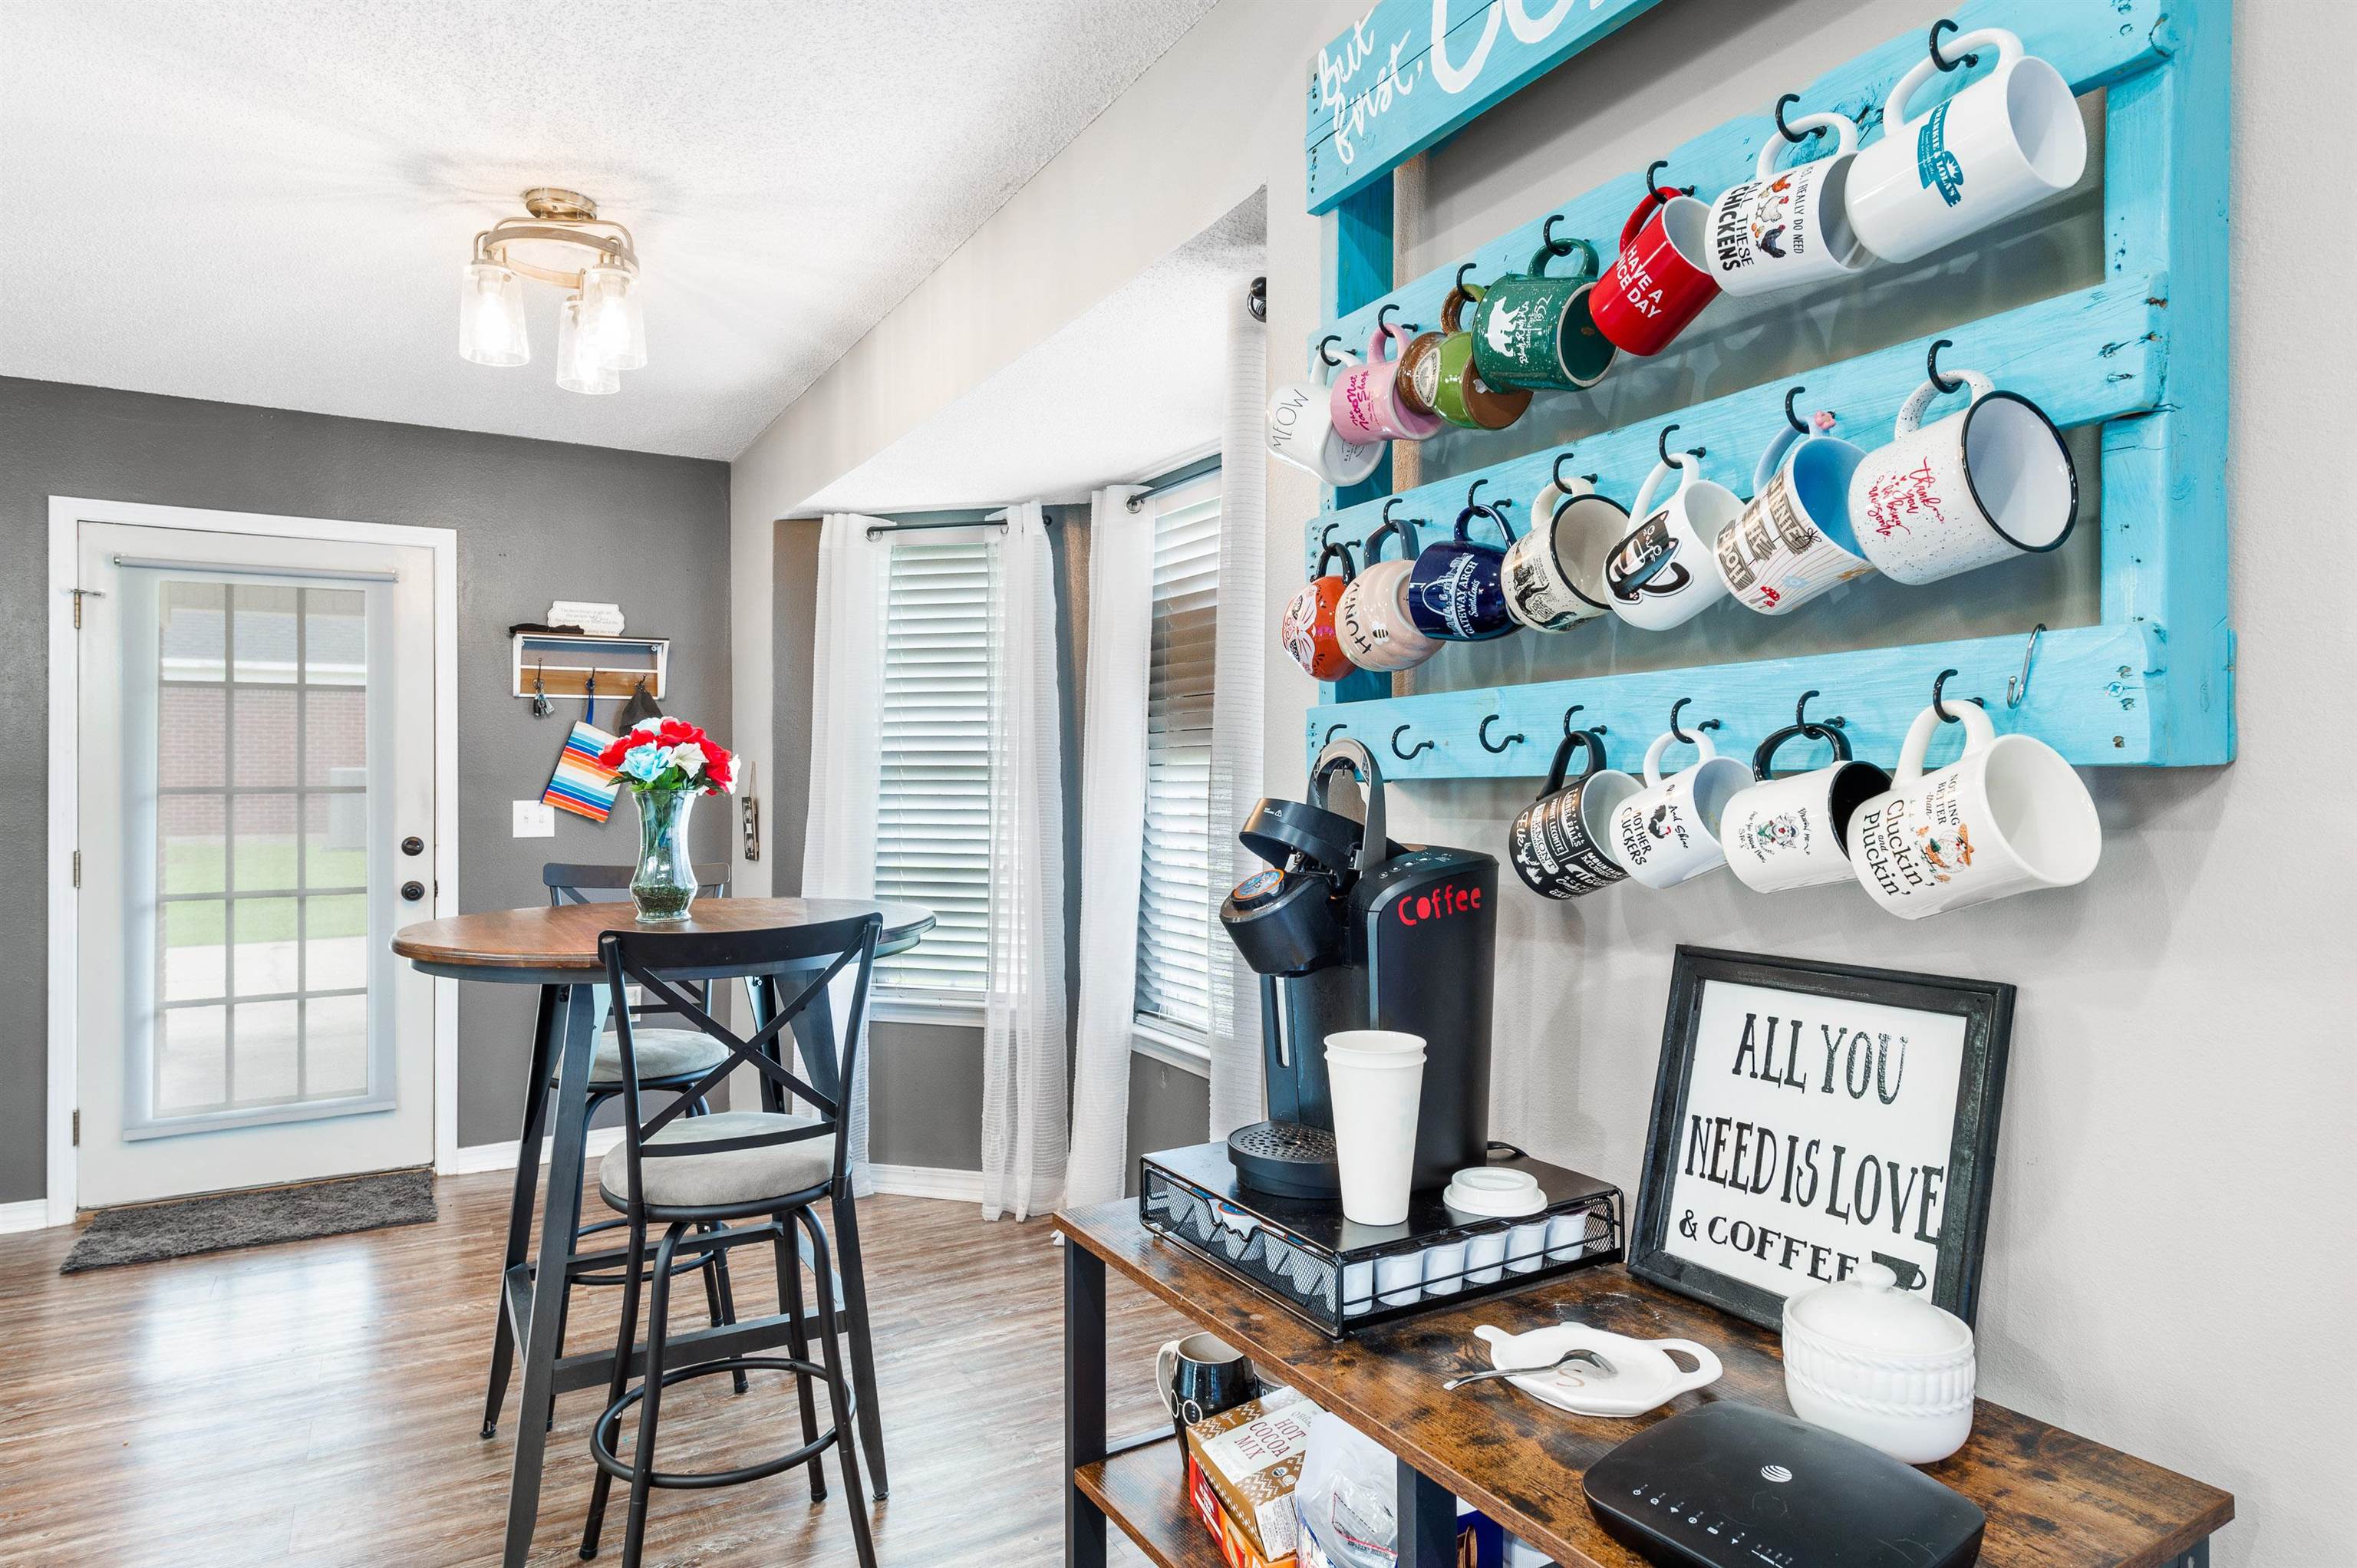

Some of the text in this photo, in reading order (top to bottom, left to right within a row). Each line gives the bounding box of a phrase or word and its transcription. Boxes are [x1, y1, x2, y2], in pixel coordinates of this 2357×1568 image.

[1794, 184, 1809, 215] REALLY
[1716, 185, 1741, 272] CHICKENS
[1736, 182, 1763, 267] ALL THESE
[1793, 219, 1804, 230] DO
[1793, 234, 1805, 254] NEED
[1627, 244, 1663, 304] HAVE A
[1627, 287, 1663, 318] DAY
[1272, 388, 1309, 460] MEOW
[1892, 488, 1919, 515] you
[1718, 529, 1747, 585] POOH
[1456, 561, 1479, 634] GATEWAY ARCH
[1668, 804, 1683, 822] And
[1549, 822, 1564, 854] LECONTE
[1567, 821, 1582, 848] FALLS
[1674, 824, 1690, 849] Shine
[1862, 809, 1912, 897] Pluckin'
[1877, 834, 1889, 853] and
[1886, 799, 1936, 888] Cluckin'
[1397, 884, 1482, 927] Coffee
[1731, 1013, 1910, 1105] ALL YOU
[1684, 1114, 1946, 1250] NEED IS LOVE
[1678, 1208, 1861, 1285] & COFFEE
[1233, 1435, 1266, 1460] MIX
[1248, 1421, 1291, 1458] COCOA
[1274, 1418, 1307, 1441] HOT
